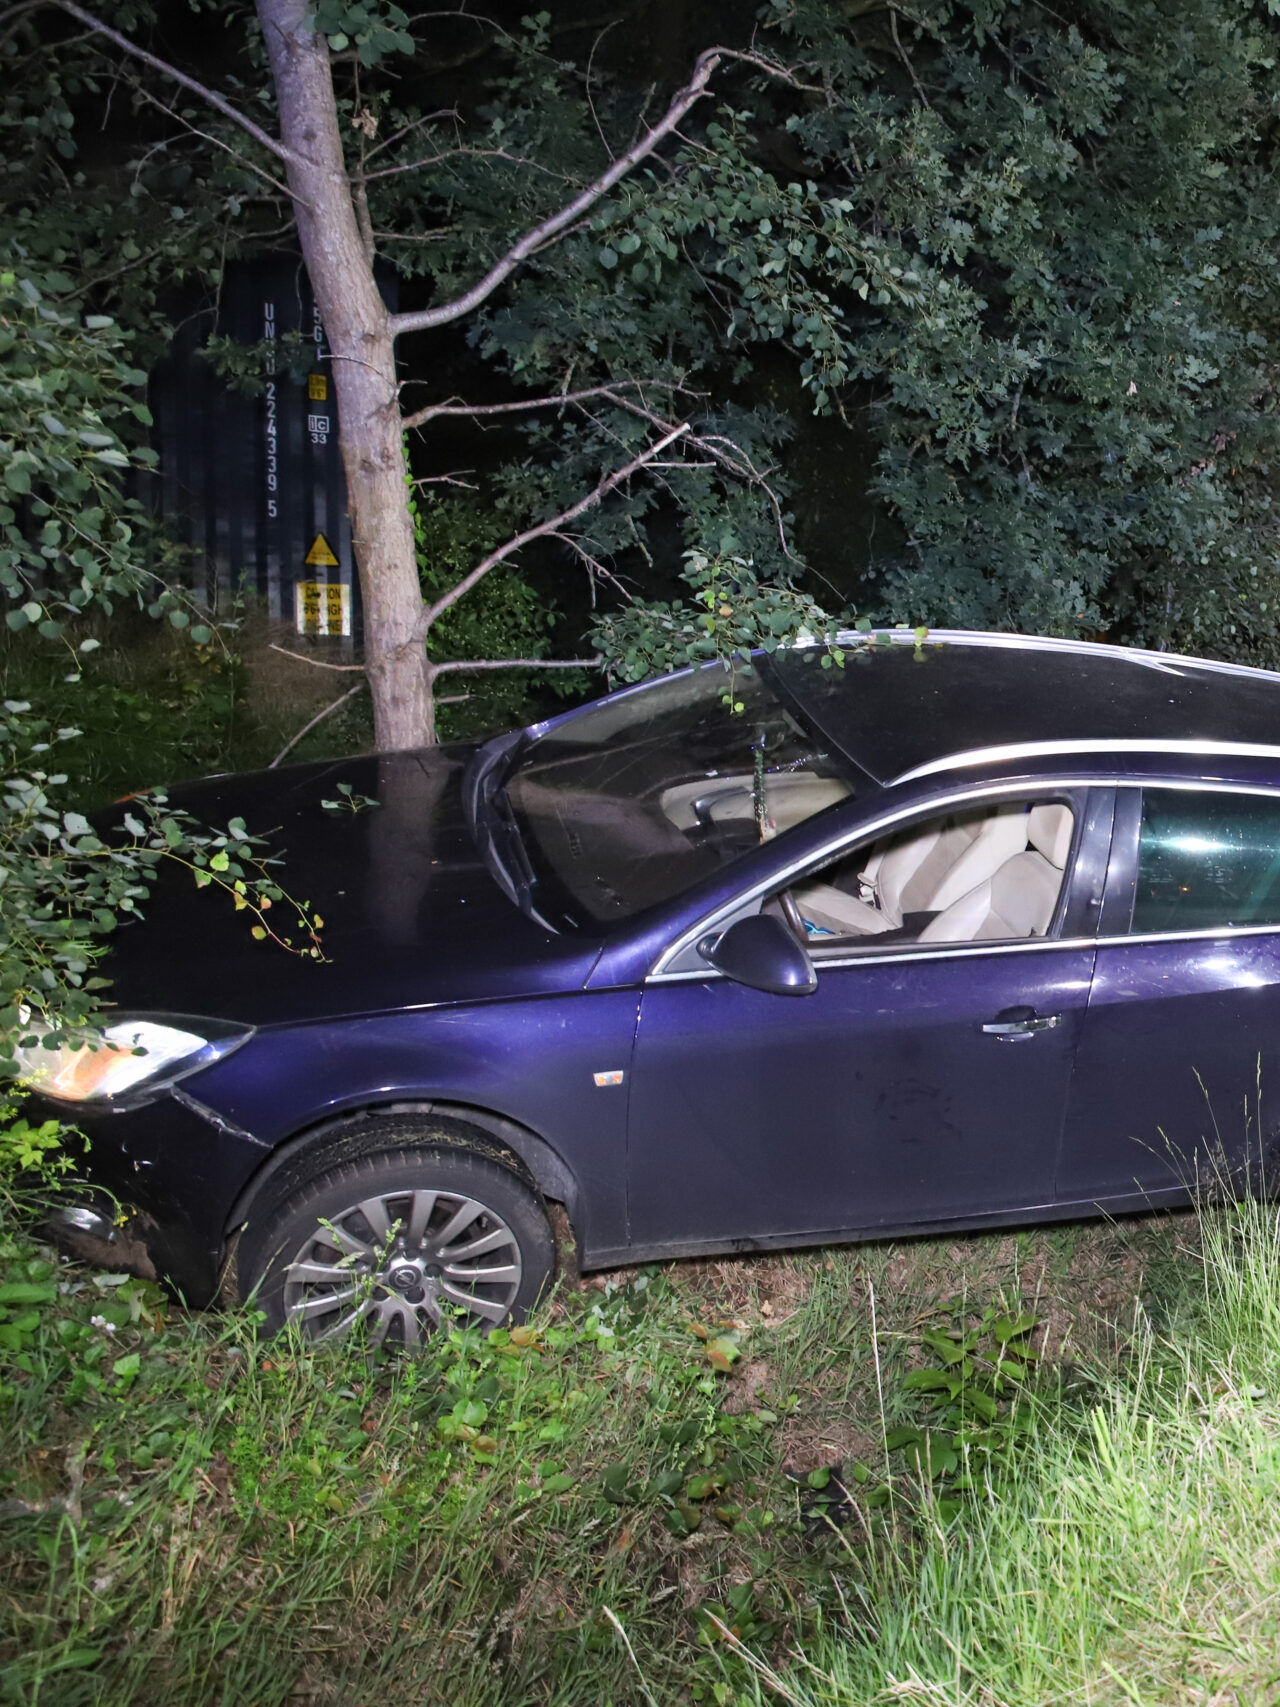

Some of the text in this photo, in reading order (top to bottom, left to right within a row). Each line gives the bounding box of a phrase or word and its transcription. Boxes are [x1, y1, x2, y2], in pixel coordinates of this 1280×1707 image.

[266, 381, 277, 492] 224339
[311, 432, 327, 445] 33
[267, 499, 278, 518] 5
